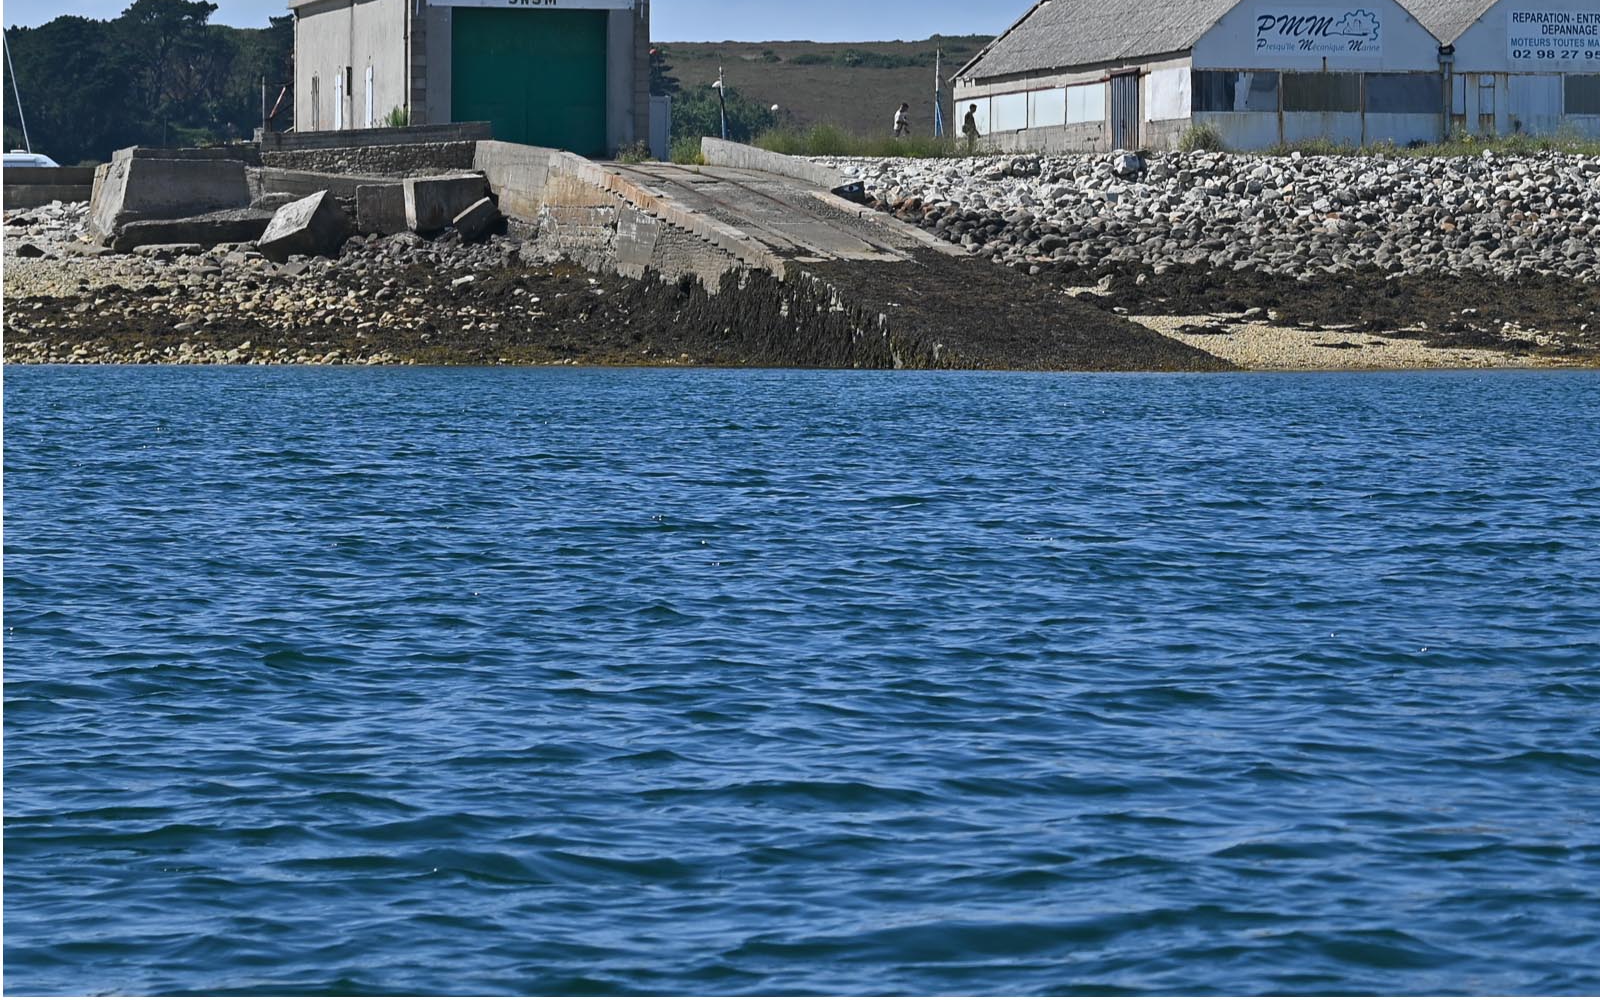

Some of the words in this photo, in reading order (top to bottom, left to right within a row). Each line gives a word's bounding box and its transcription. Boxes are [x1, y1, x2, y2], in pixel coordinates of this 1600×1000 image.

[1512, 12, 1570, 24] REPARATION
[1256, 14, 1334, 37] PMM
[1541, 24, 1598, 36] DEPANNAGE
[1347, 39, 1380, 52] Marine
[1510, 37, 1551, 48] MOTEURS
[1553, 38, 1585, 48] TOUTES
[1512, 50, 1532, 60] 02
[1536, 50, 1555, 60] 98
[1560, 50, 1579, 60] 27
